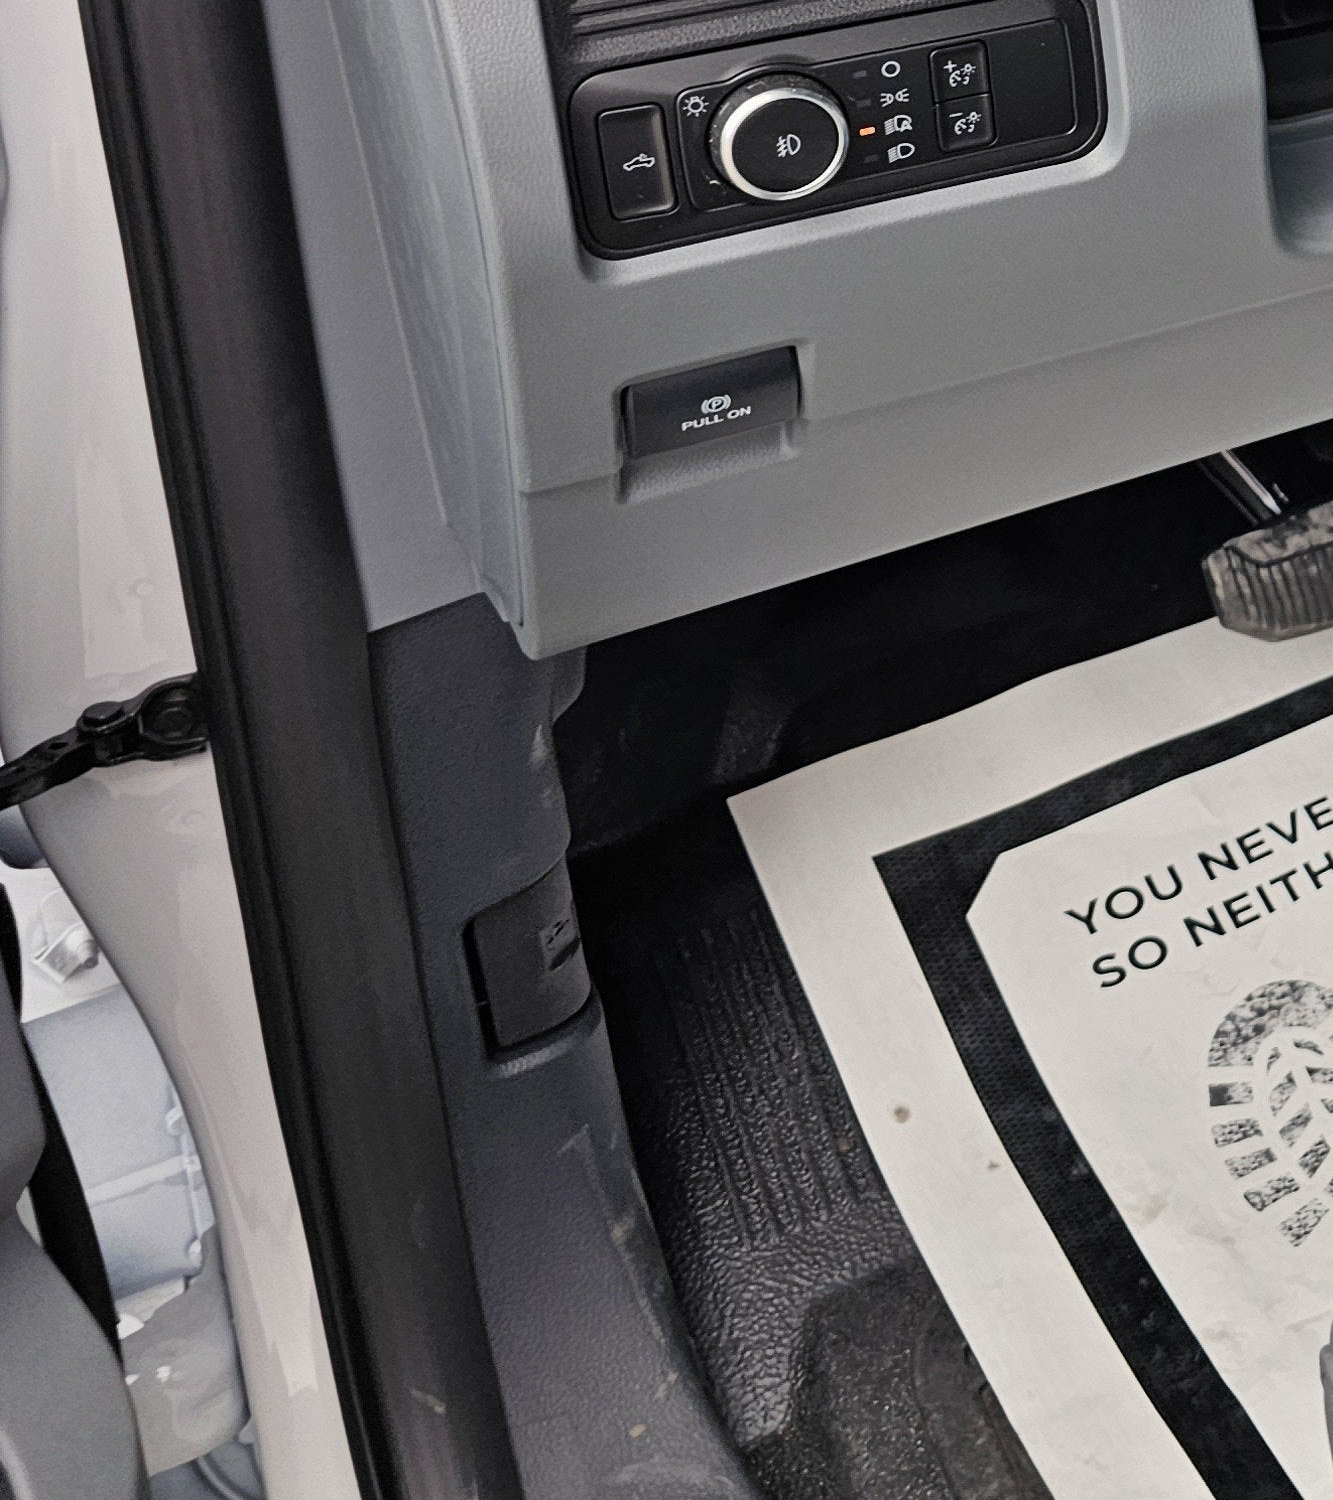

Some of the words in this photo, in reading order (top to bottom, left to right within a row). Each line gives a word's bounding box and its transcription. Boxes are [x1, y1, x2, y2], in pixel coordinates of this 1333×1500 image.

[681, 414, 724, 432] PULL
[727, 405, 751, 419] ON
[1064, 864, 1185, 936] YOU
[1091, 935, 1168, 989] SO
